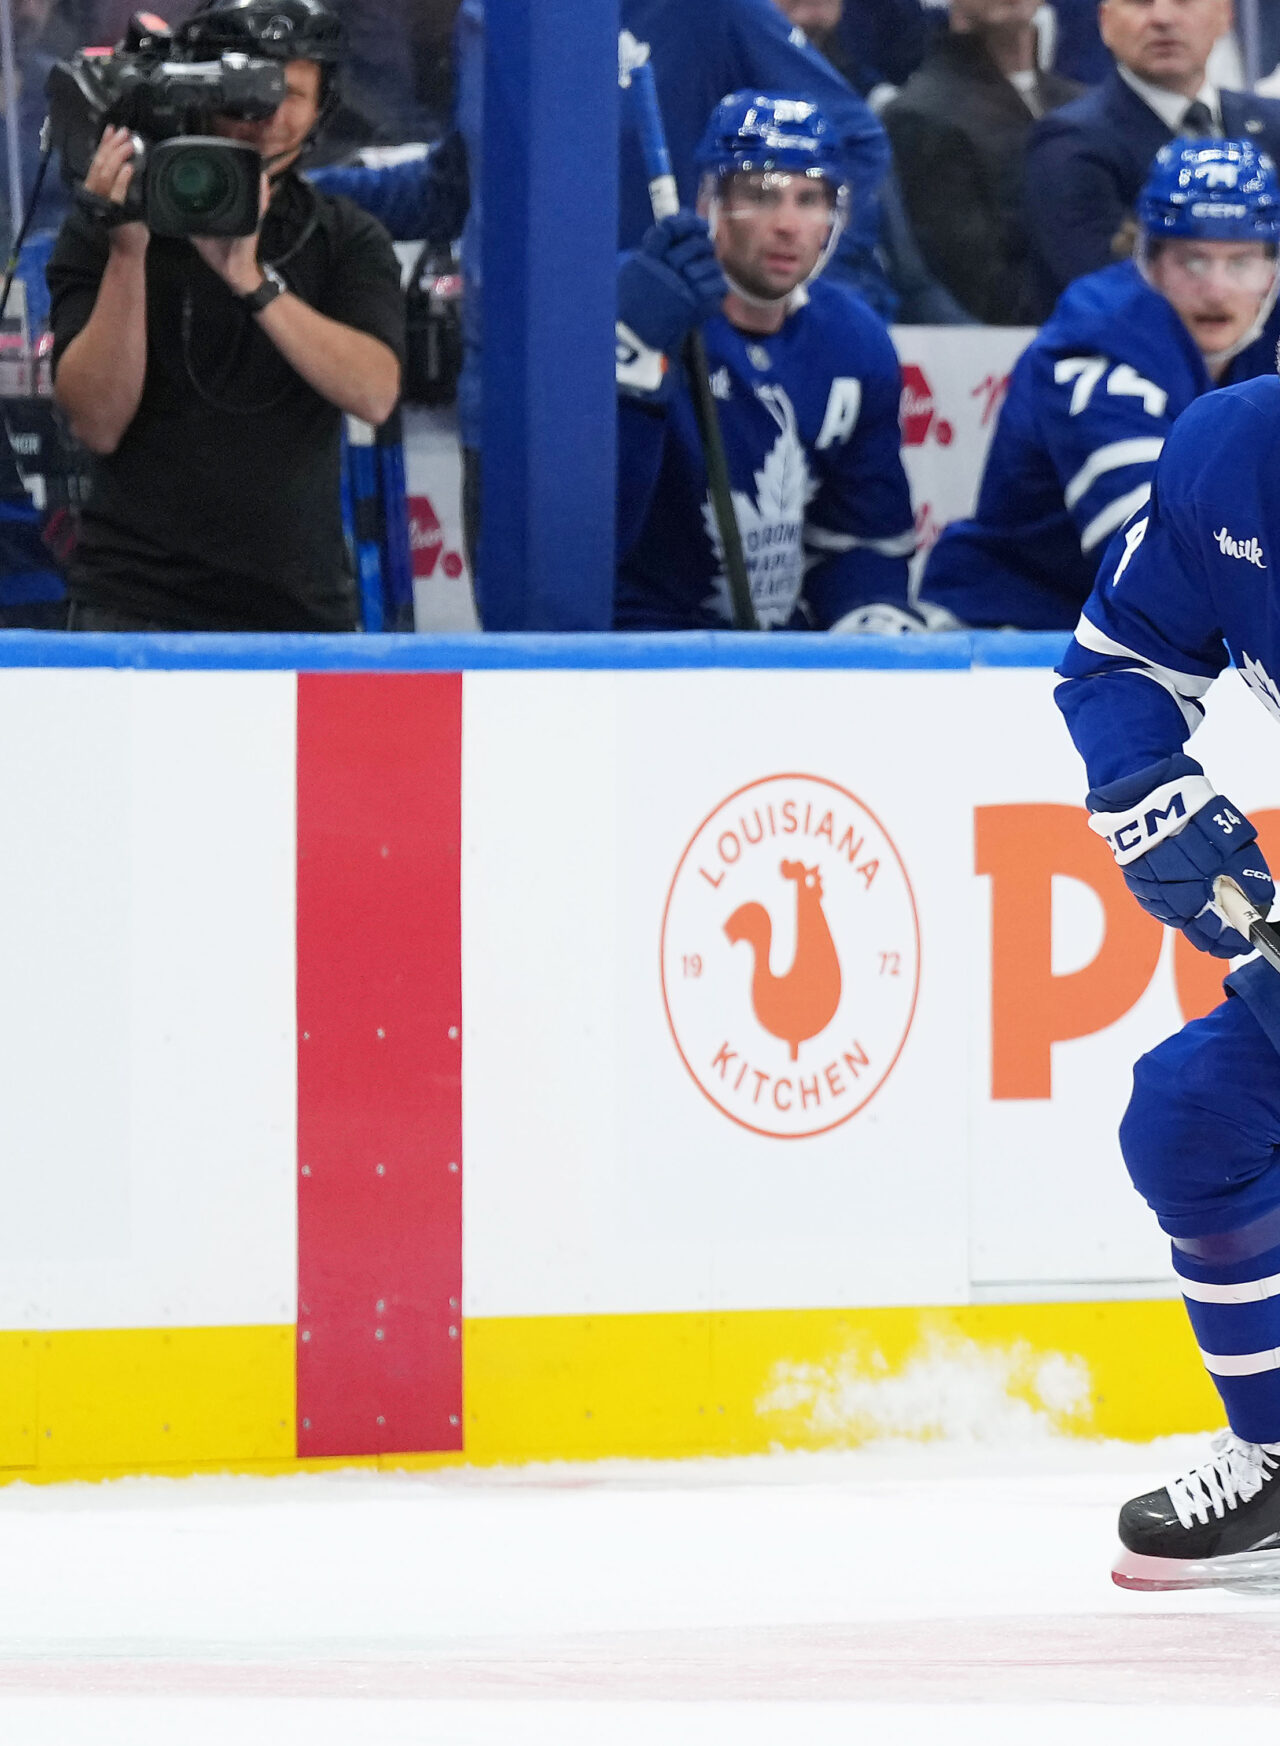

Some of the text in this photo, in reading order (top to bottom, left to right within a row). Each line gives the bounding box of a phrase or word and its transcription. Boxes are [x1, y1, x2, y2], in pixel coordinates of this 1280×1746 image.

[815, 377, 861, 449] A
[1213, 527, 1267, 568] Milk
[699, 799, 880, 890] LOUISIANA
[1106, 791, 1187, 855] CM
[1213, 807, 1242, 835] 34
[1242, 868, 1272, 883] CCM
[681, 951, 901, 979] 19 72
[711, 1039, 871, 1112] KITCHEN
